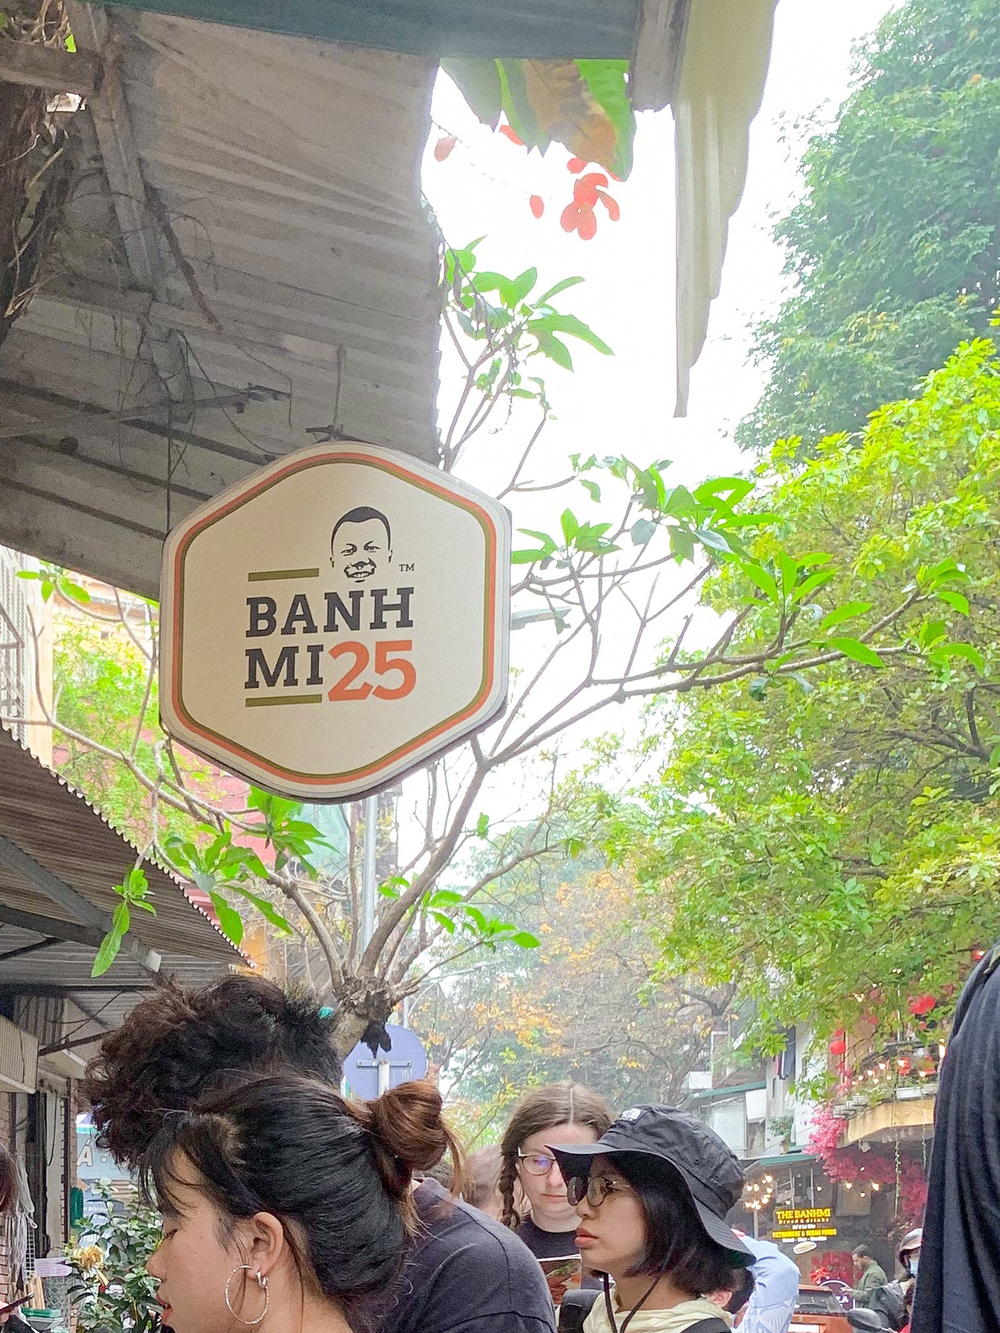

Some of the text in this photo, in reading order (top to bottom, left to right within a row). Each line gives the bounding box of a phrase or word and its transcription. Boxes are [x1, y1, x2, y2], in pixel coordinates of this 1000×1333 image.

[399, 563, 415, 572] TM
[245, 586, 415, 638] BANH
[776, 1208, 831, 1220] THE BANHMI
